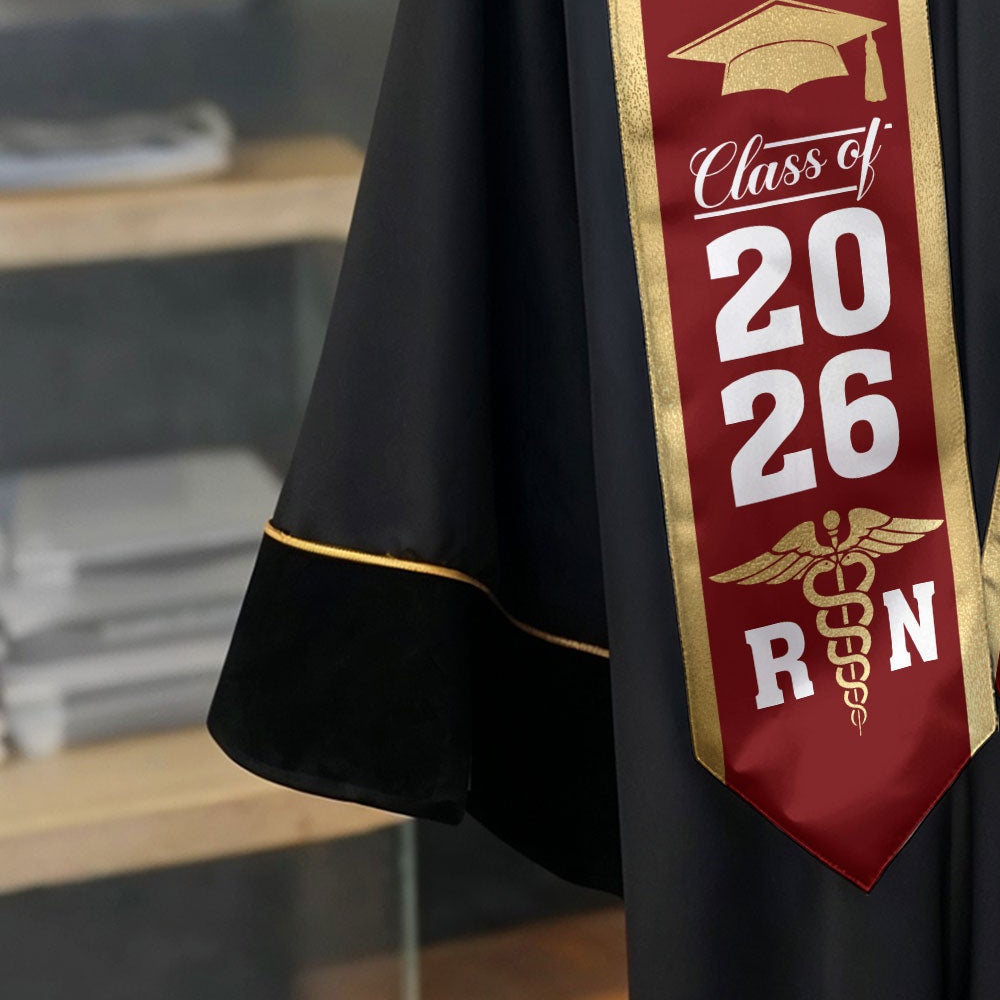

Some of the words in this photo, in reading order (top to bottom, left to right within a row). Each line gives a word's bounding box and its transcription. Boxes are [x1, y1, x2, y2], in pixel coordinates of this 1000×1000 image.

[689, 133, 828, 209] Class
[836, 117, 882, 202] of
[705, 206, 891, 363] 20
[720, 348, 900, 508] 26
